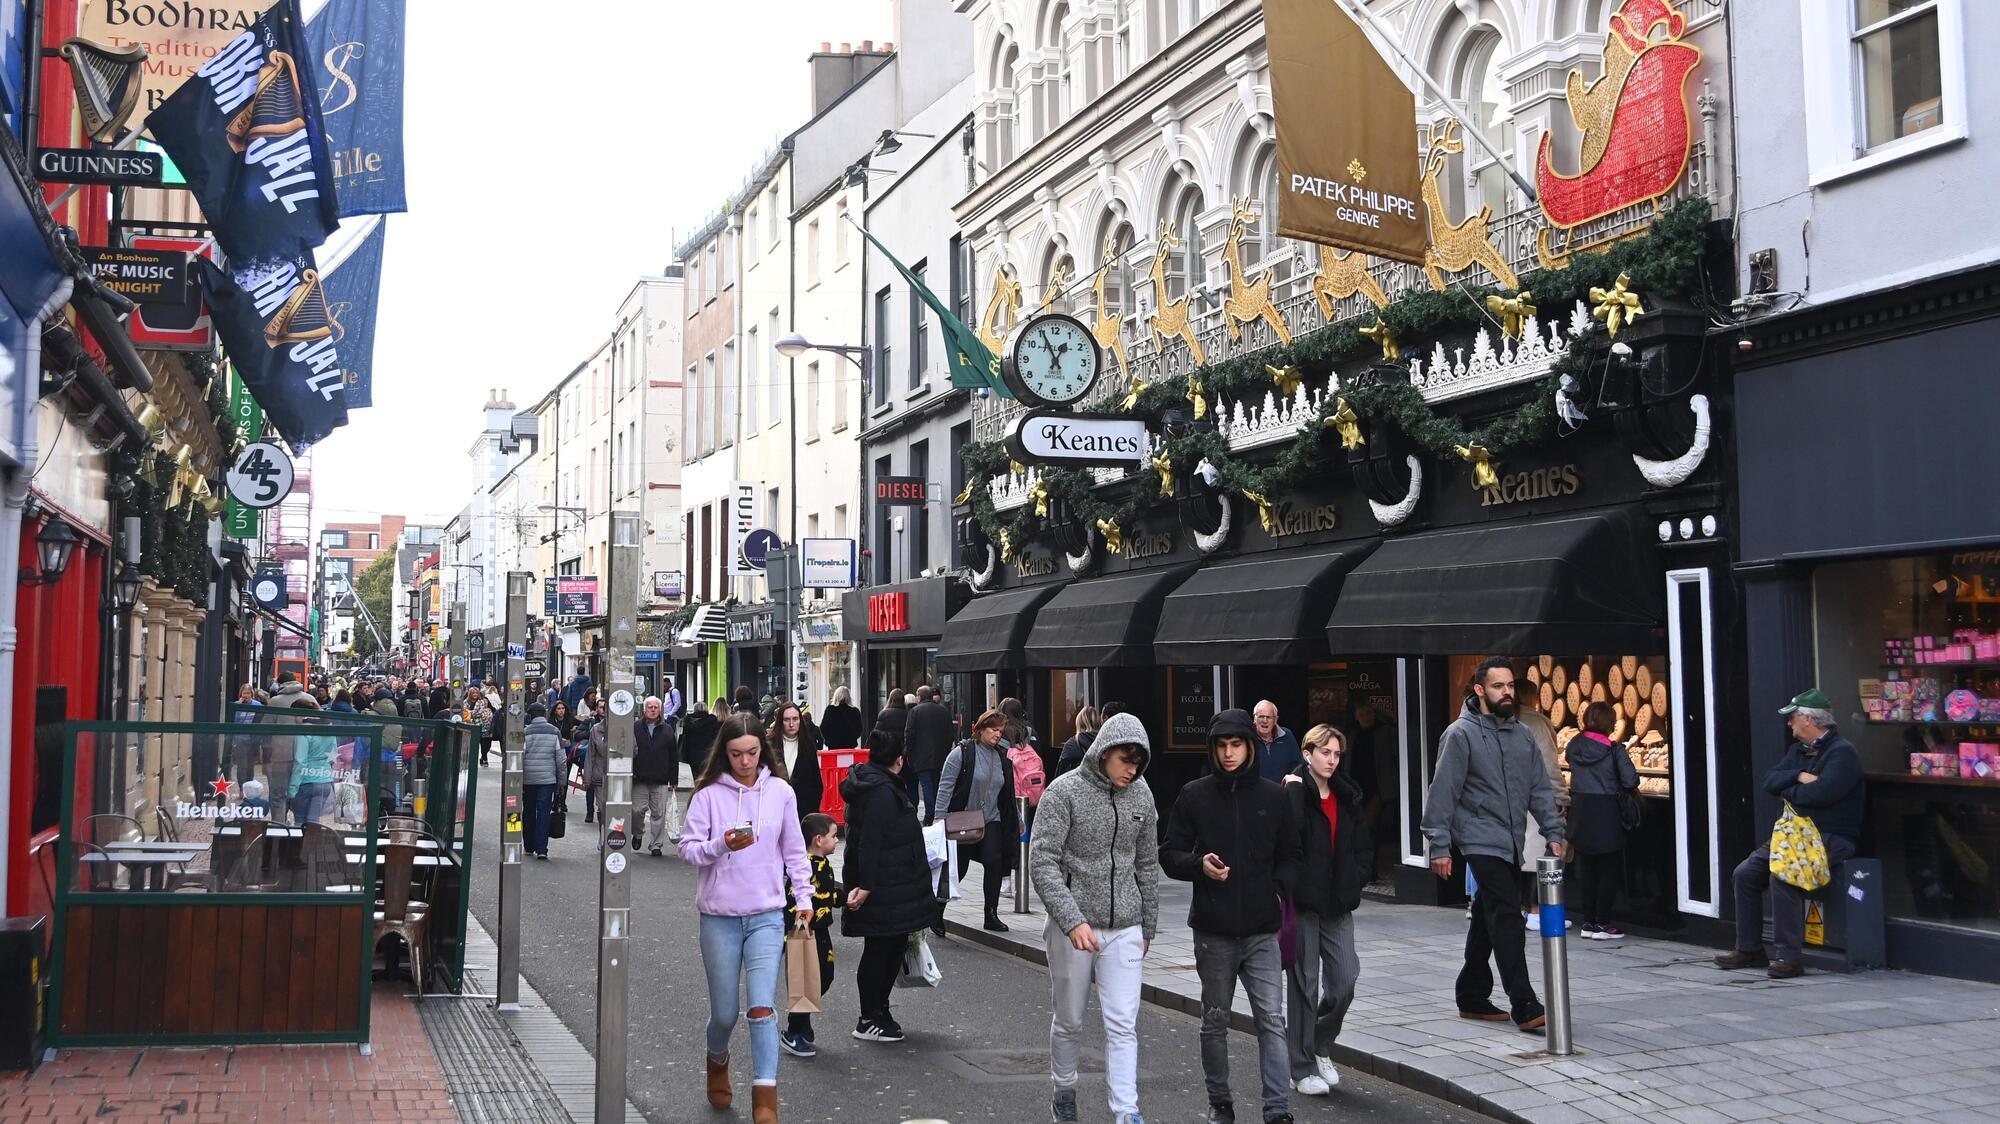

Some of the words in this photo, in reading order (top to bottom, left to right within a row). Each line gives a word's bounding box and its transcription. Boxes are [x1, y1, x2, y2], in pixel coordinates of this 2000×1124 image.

[107, 36, 222, 59] Traditio
[40, 152, 154, 176] GUINNESS
[334, 147, 383, 178] ille
[1291, 173, 1348, 203] PATEK
[1350, 186, 1417, 220] PHILIPPE
[1336, 206, 1380, 229] GENEVE
[122, 264, 175, 280] MUSIC
[103, 281, 162, 294] ONIGHT
[1051, 327, 1061, 335] 12
[1027, 340, 1037, 349] 10
[1077, 343, 1084, 351] 2
[1022, 355, 1029, 364] 9
[1080, 358, 1087, 367] 3
[1026, 370, 1033, 379] 8
[1076, 374, 1083, 382] 4
[1037, 382, 1043, 391] 7
[1066, 384, 1072, 393] 5
[1050, 387, 1057, 396] 6
[240, 397, 252, 417] OF
[1041, 424, 1138, 452] Keanes
[877, 481, 925, 499] DIESEL
[868, 591, 910, 633] DIESEL
[1348, 681, 1381, 690] OMEGA
[1181, 695, 1214, 703] ROLEX
[1175, 726, 1206, 734] TUDOR
[175, 801, 265, 819] Heineken
